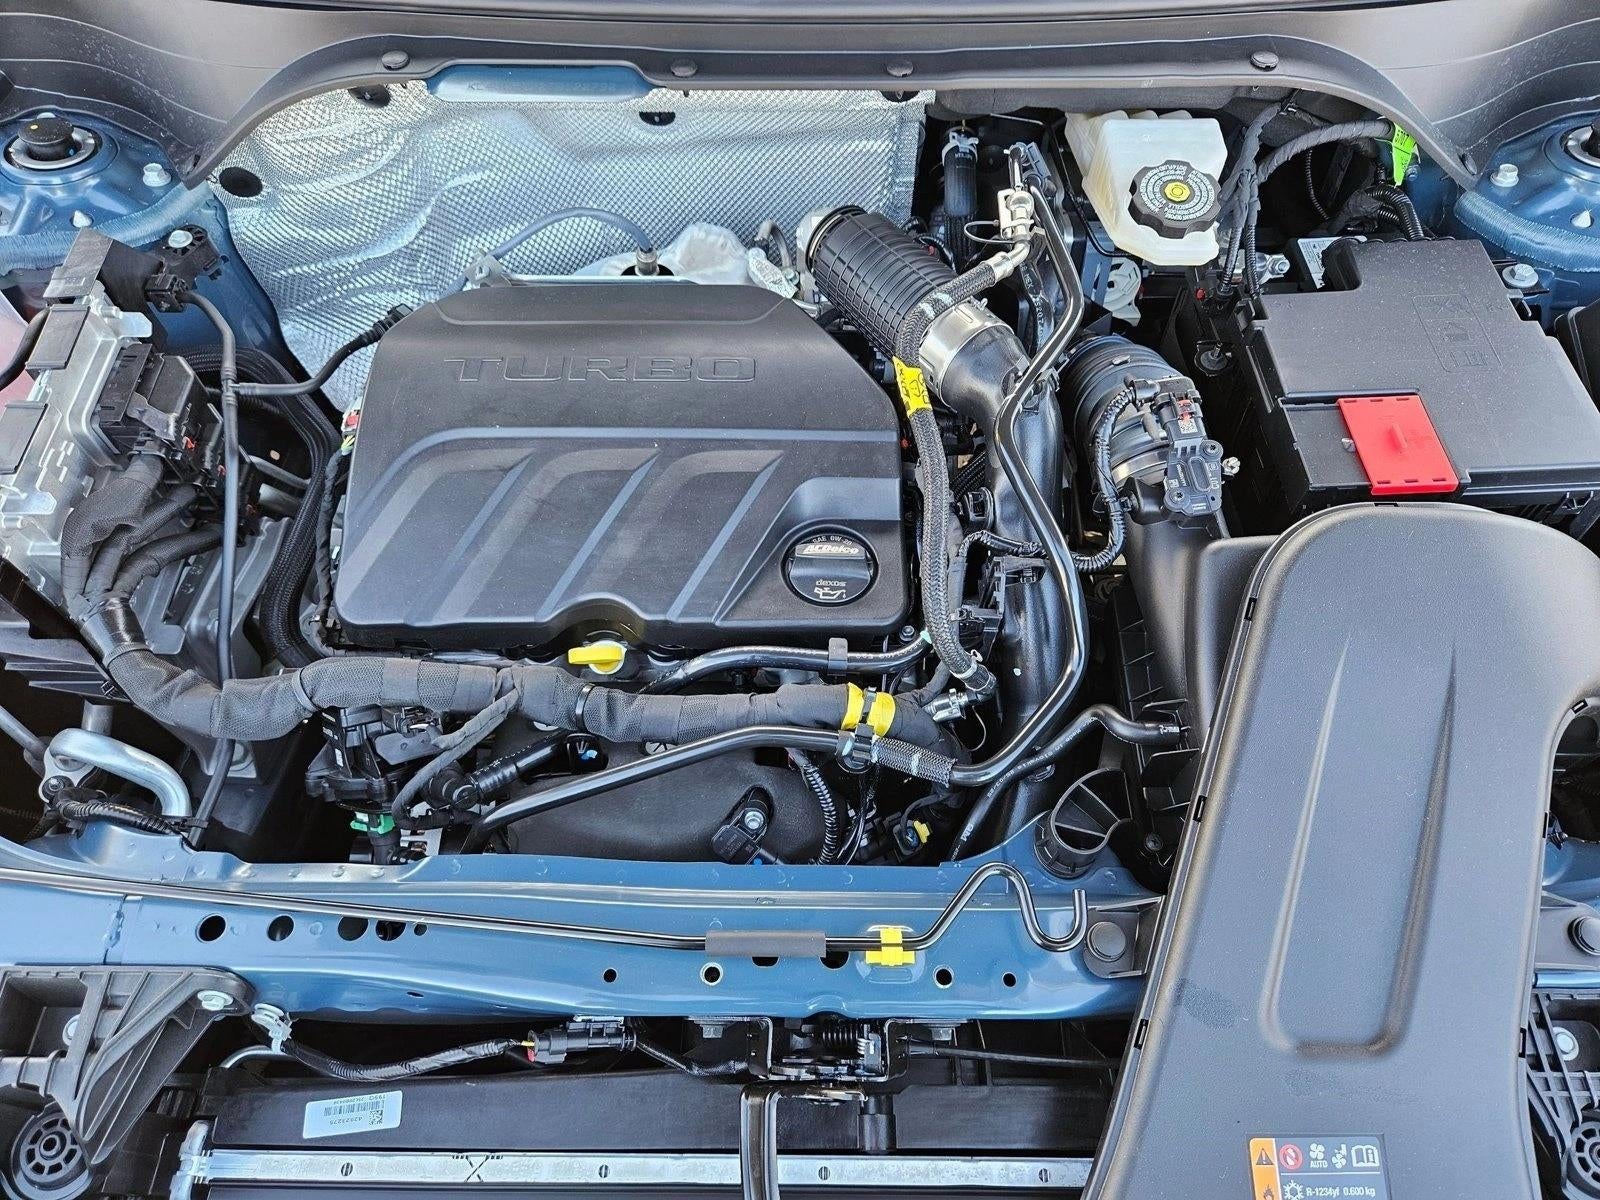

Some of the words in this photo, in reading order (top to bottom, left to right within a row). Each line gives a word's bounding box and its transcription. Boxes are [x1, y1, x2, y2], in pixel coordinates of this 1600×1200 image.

[444, 356, 756, 382] TURBO
[803, 544, 860, 555] ACDelco
[1310, 1160, 1328, 1168] AUTO
[1306, 1187, 1340, 1198] R-1234yf
[1343, 1186, 1365, 1196] 0.600
[1365, 1186, 1376, 1198] kg
